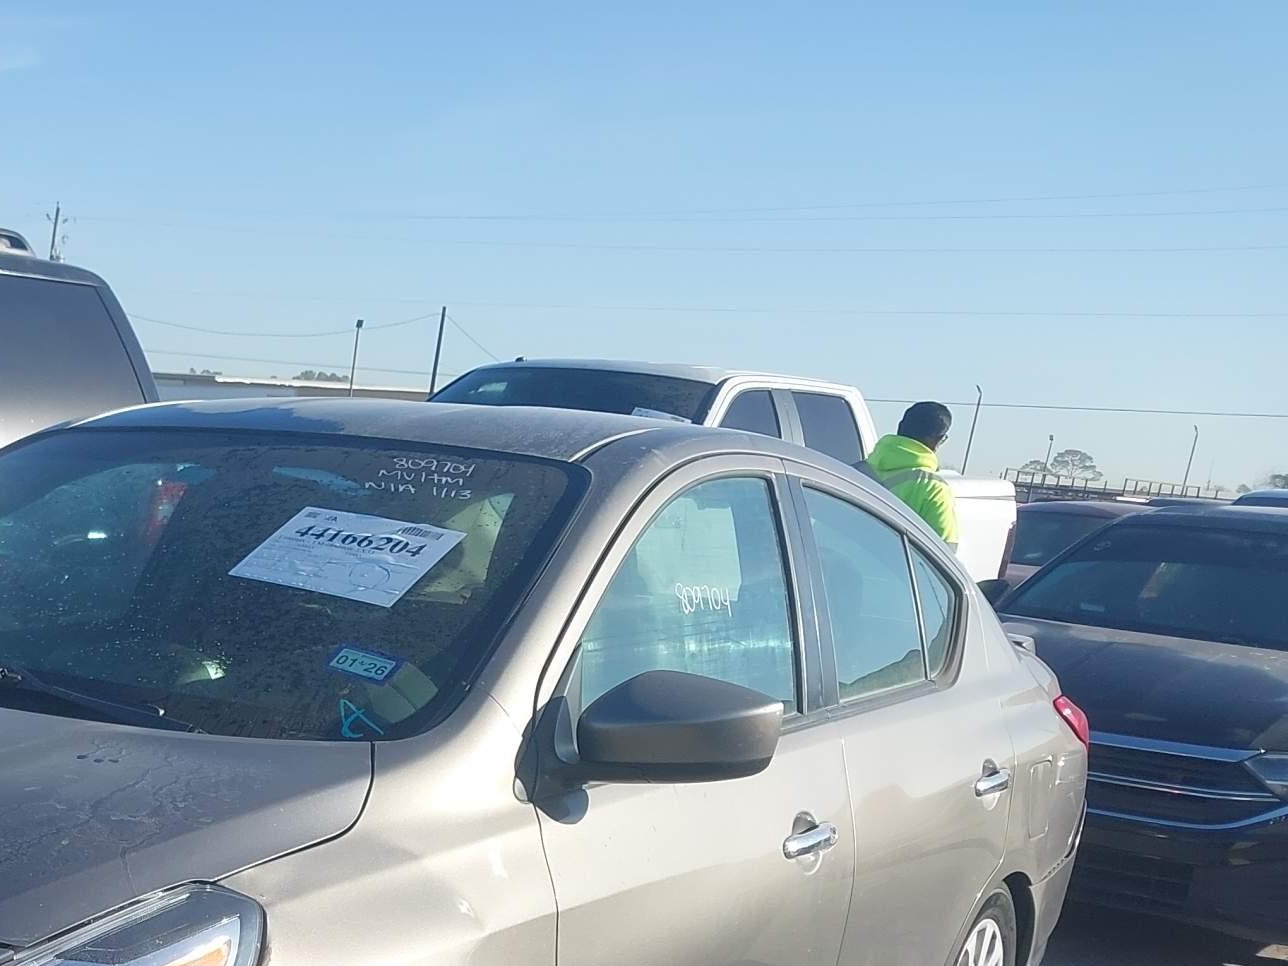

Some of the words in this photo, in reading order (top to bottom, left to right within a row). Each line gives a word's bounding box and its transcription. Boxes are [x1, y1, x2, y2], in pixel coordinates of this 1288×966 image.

[393, 457, 476, 477] 809704
[295, 524, 428, 557] 44166204
[674, 582, 733, 618] 809704
